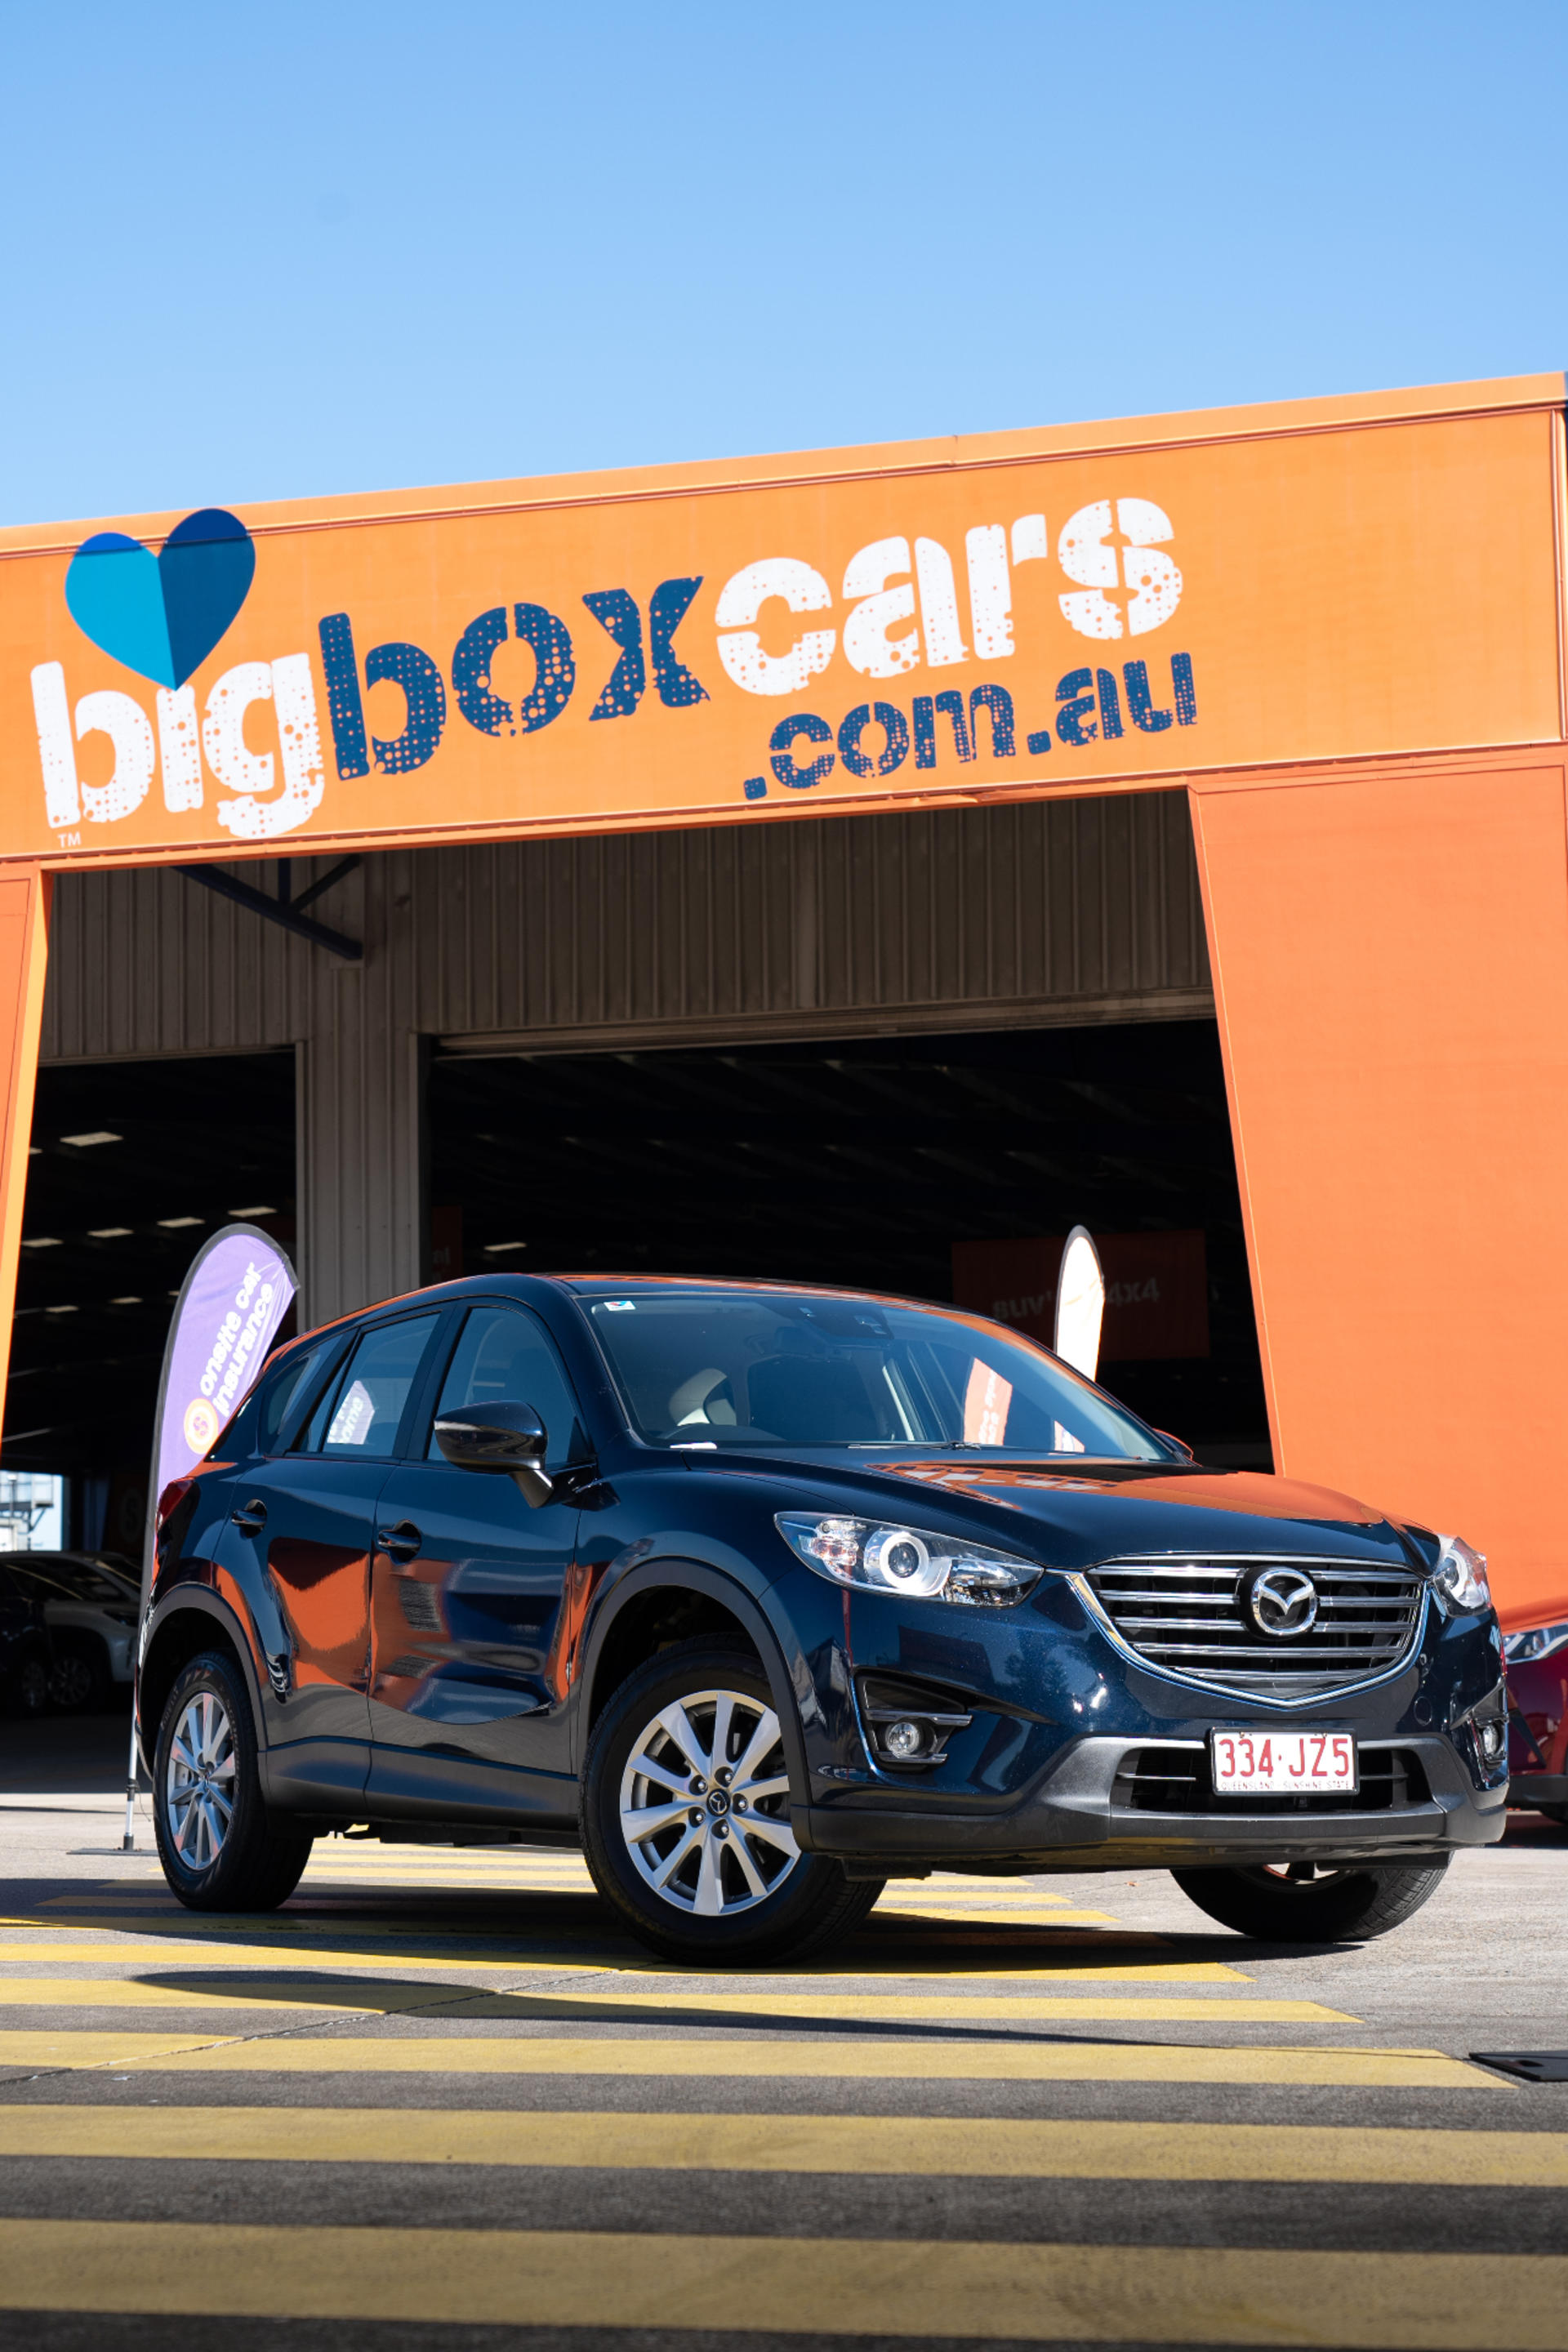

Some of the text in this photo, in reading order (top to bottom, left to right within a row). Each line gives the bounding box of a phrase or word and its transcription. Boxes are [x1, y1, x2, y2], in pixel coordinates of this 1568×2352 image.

[57, 831, 82, 848] TM
[199, 1310, 243, 1397] onsite
[234, 1261, 263, 1310] car
[212, 1282, 274, 1418] insurance
[1221, 1780, 1350, 1791] QUEENSLAND SUNSHINE STATE
